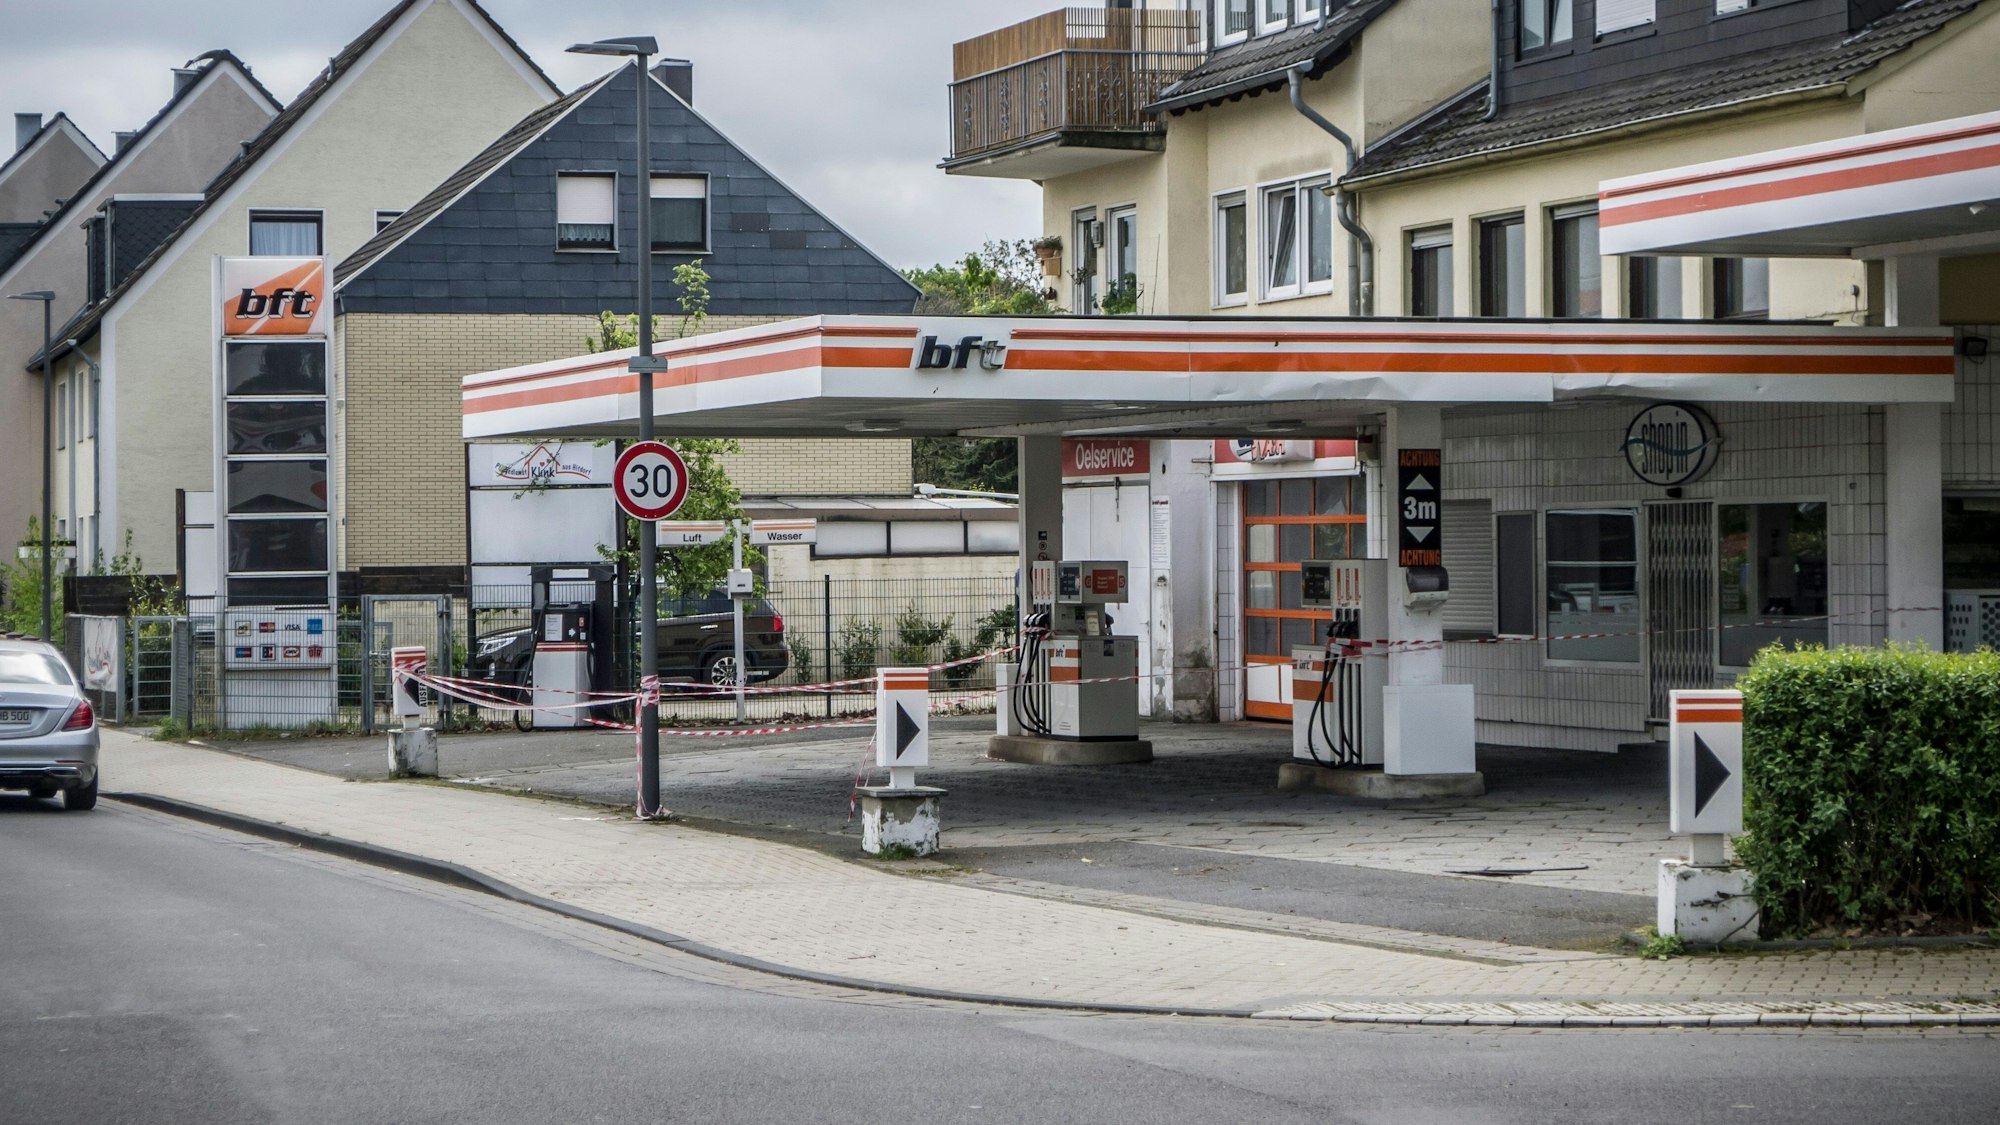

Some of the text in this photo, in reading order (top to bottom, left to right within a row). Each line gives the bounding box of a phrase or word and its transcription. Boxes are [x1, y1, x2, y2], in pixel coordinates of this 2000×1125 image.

[235, 288, 316, 319] bft
[915, 335, 1006, 369] bft
[1642, 410, 1688, 480] shop in
[1075, 440, 1134, 470] Oelservice
[1400, 450, 1440, 467] ACHTUNG
[531, 466, 555, 478] Klink
[630, 464, 672, 498] 30
[1403, 496, 1437, 520] 3m
[683, 533, 702, 542] Luft
[767, 532, 802, 541] Wasser
[1400, 549, 1440, 566] ACHTUNG
[1055, 648, 1064, 658] bft
[10, 711, 29, 721] 500
